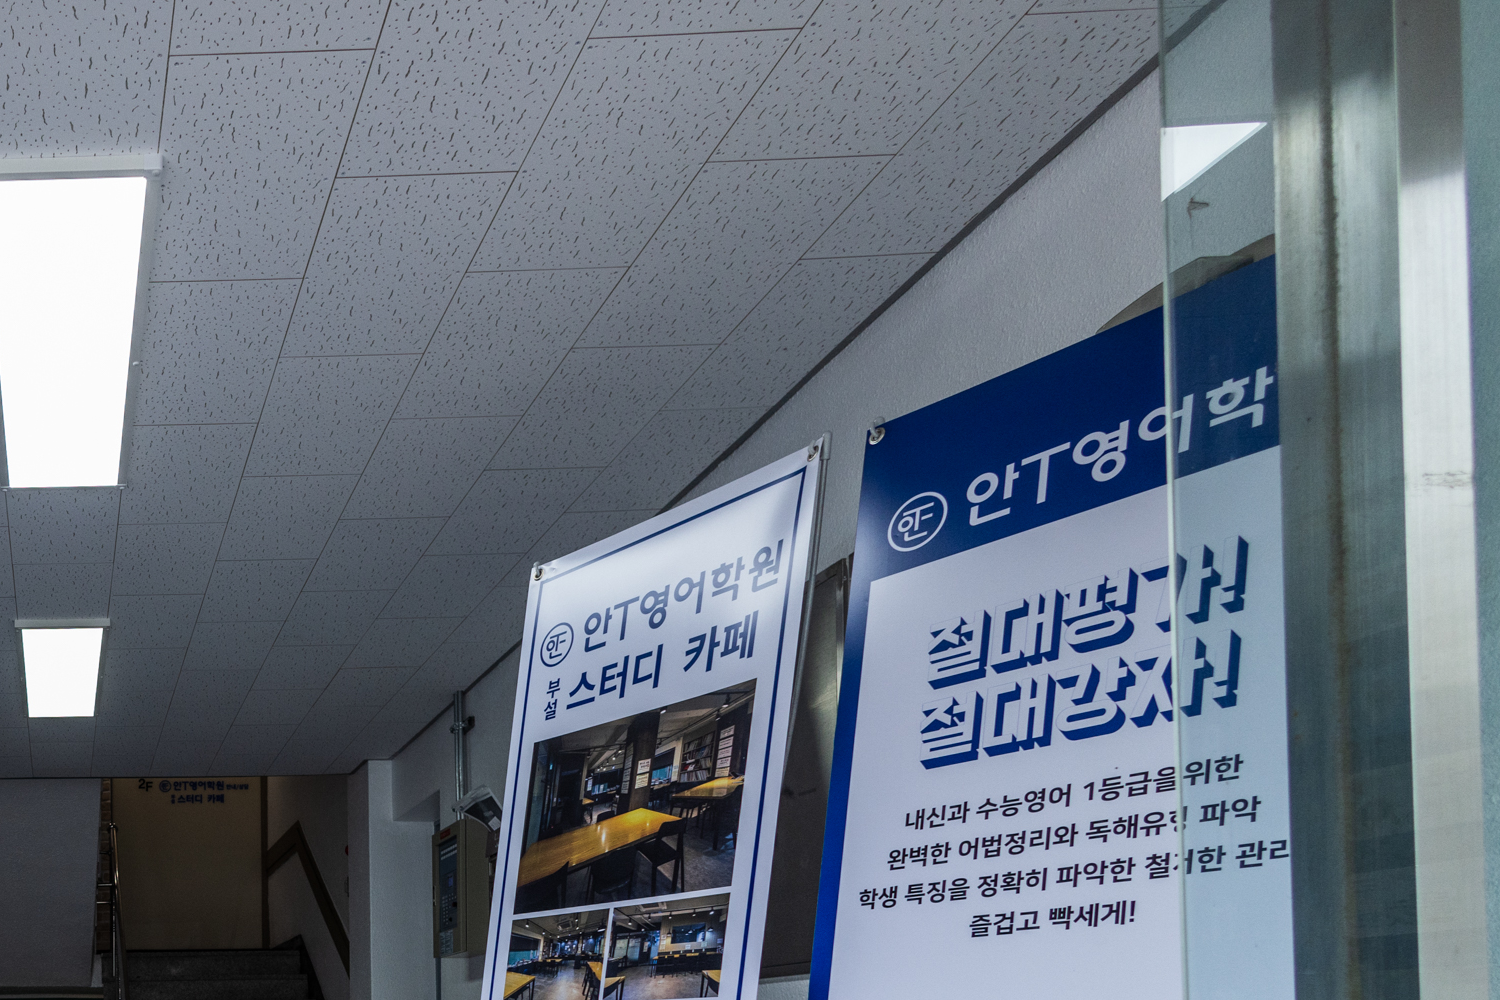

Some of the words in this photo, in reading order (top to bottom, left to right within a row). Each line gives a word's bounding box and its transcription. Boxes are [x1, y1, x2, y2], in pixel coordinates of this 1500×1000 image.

[584, 539, 784, 653] 안T영어학원
[927, 535, 1248, 690] 절대평가!
[543, 678, 562, 721] 부설
[566, 644, 663, 711] 스터디
[683, 610, 759, 673] 카페
[919, 629, 1242, 770] 절대강자!
[138, 778, 153, 792] 2F
[173, 781, 224, 791] 안T영어학원
[177, 794, 203, 804] 스터디
[207, 794, 225, 804] 카페
[904, 802, 970, 831] 내신과
[975, 783, 1073, 820] 수능영어
[1083, 765, 1176, 803] 1등급을
[1183, 754, 1244, 785] 위한
[887, 841, 952, 870] 완벽한
[958, 823, 1078, 860] 어법정리와
[1199, 795, 1262, 827] 파악
[858, 885, 898, 910] 학생
[904, 877, 970, 906] 특징을
[977, 866, 1048, 897] 정확히
[1056, 857, 1136, 889] 파악한
[968, 914, 1041, 938] 즐겁고
[1048, 900, 1137, 930] 빡세게!
